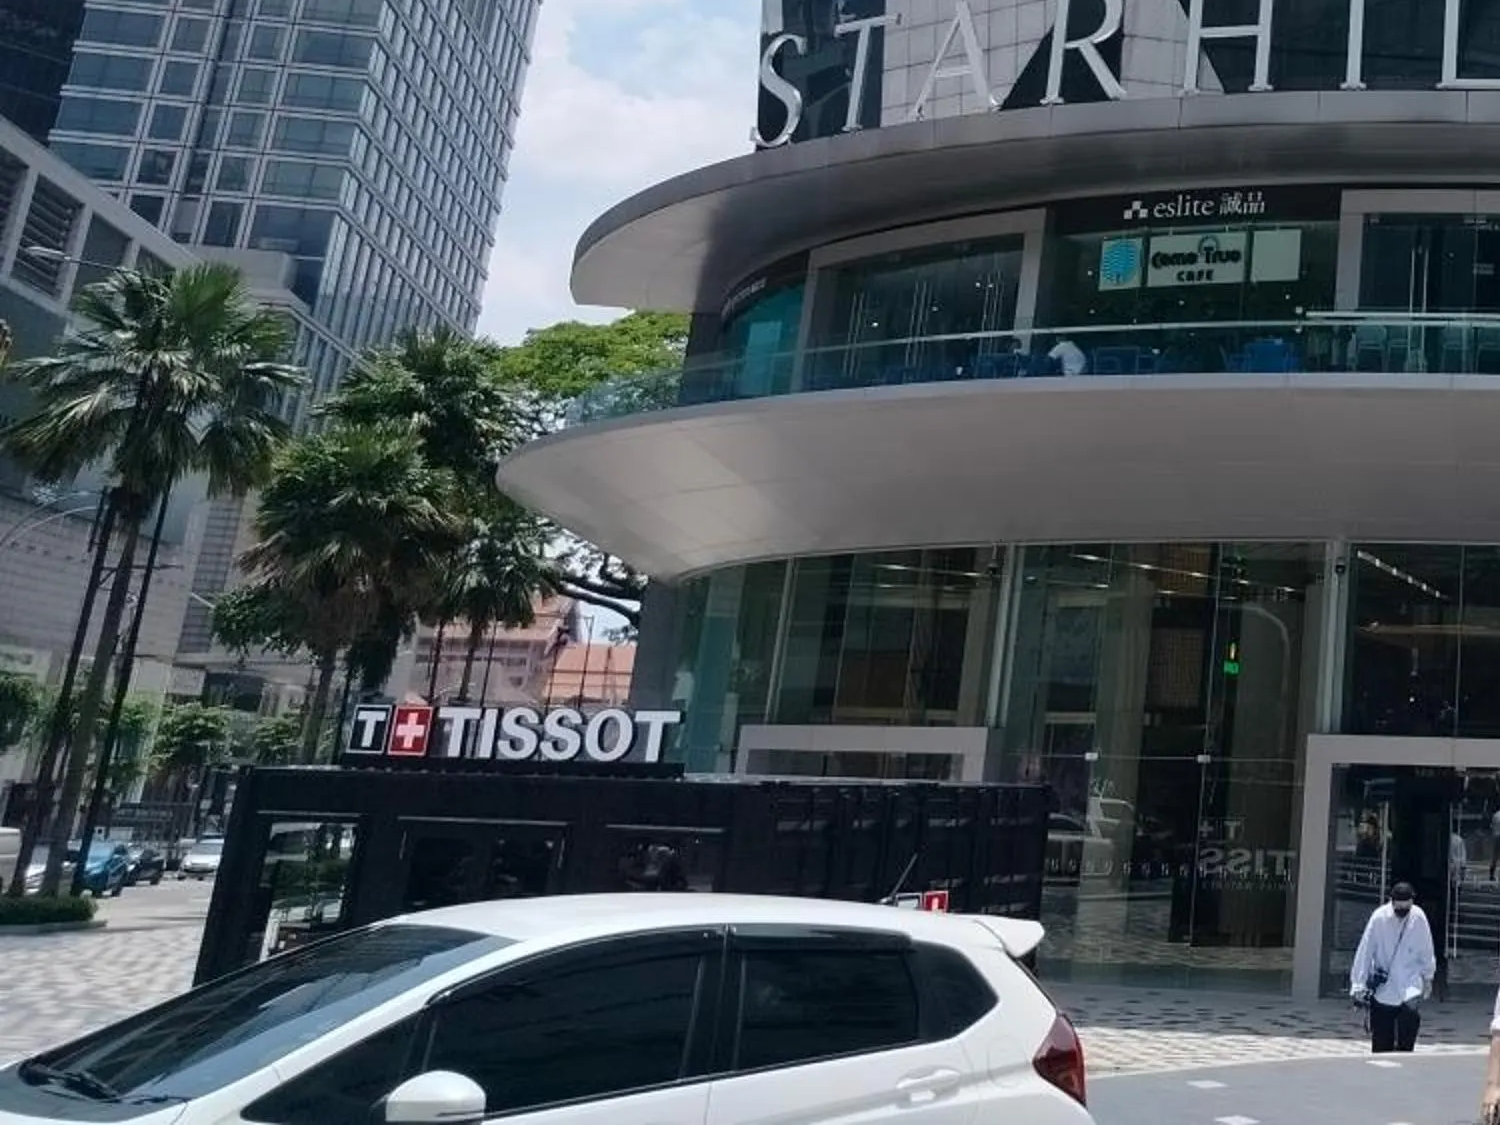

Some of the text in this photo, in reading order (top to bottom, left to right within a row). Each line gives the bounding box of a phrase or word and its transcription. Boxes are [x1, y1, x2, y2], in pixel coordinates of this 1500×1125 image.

[1153, 194, 1216, 219] eslite
[1204, 246, 1242, 265] True
[356, 707, 682, 763] T TISSOT
